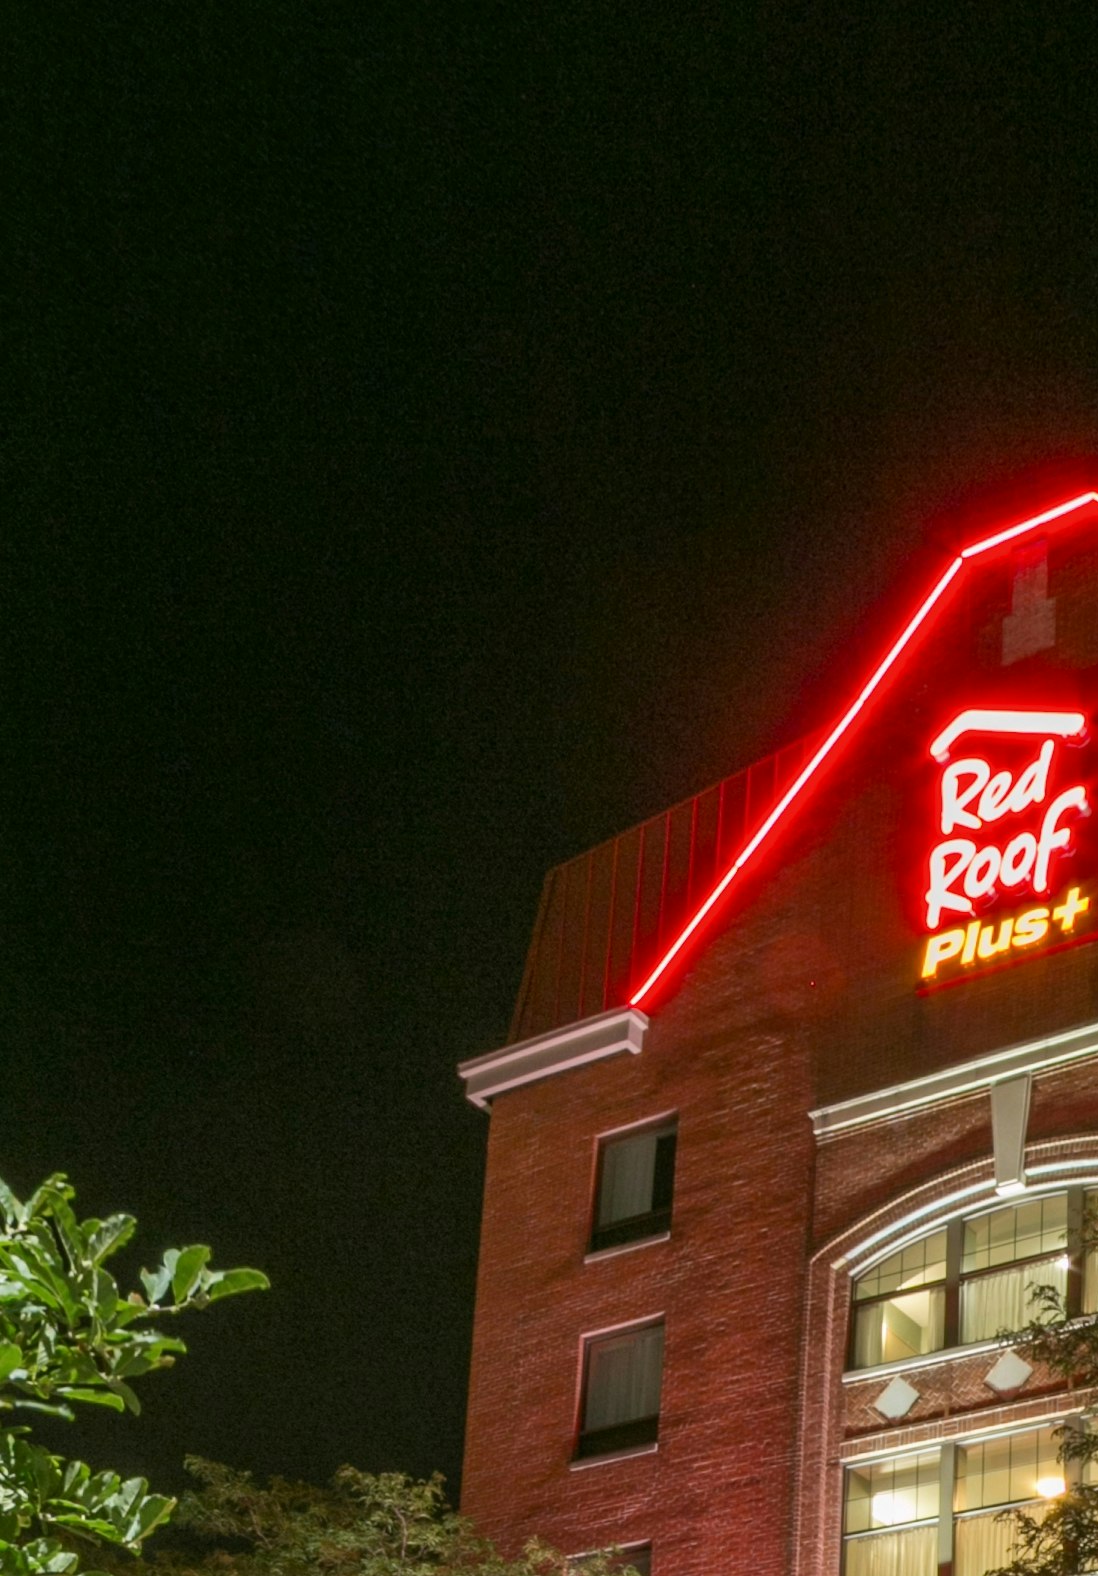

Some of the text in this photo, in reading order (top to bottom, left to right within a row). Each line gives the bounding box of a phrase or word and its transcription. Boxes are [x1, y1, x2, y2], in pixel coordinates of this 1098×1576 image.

[941, 738, 1055, 835] Red
[925, 786, 1086, 929] Roof
[920, 886, 1090, 979] Plus+
